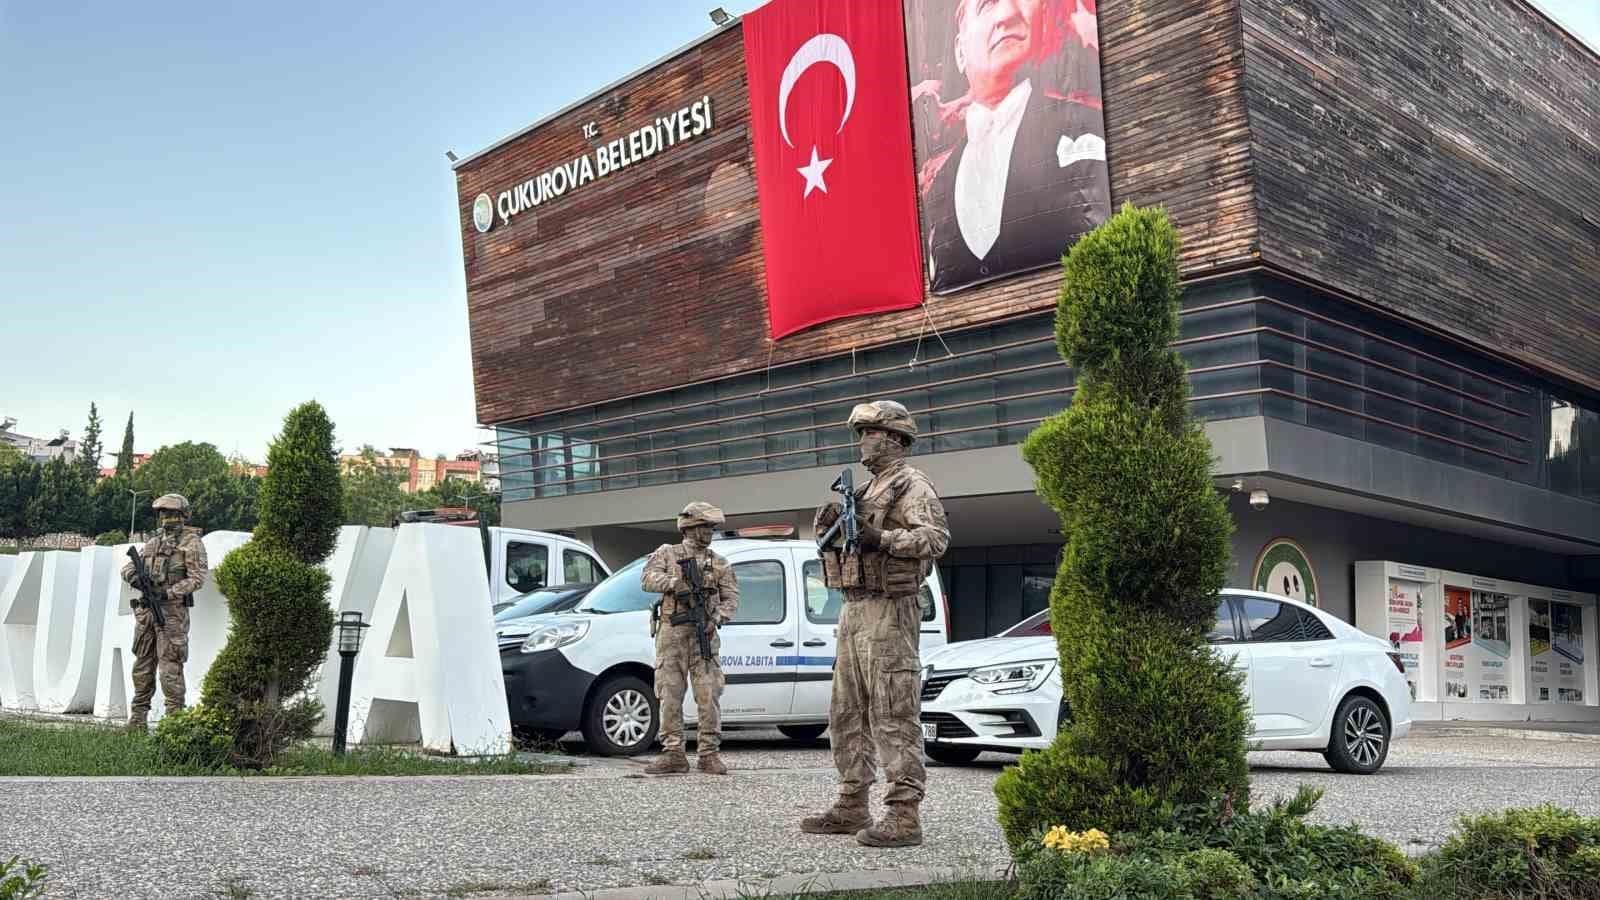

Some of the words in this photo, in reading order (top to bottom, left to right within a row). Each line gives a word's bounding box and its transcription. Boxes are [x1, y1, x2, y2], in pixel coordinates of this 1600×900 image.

[497, 156, 594, 224] ÇUKUROVA
[596, 95, 712, 176] BELEDİYESİ
[745, 655, 774, 666] ZABITA
